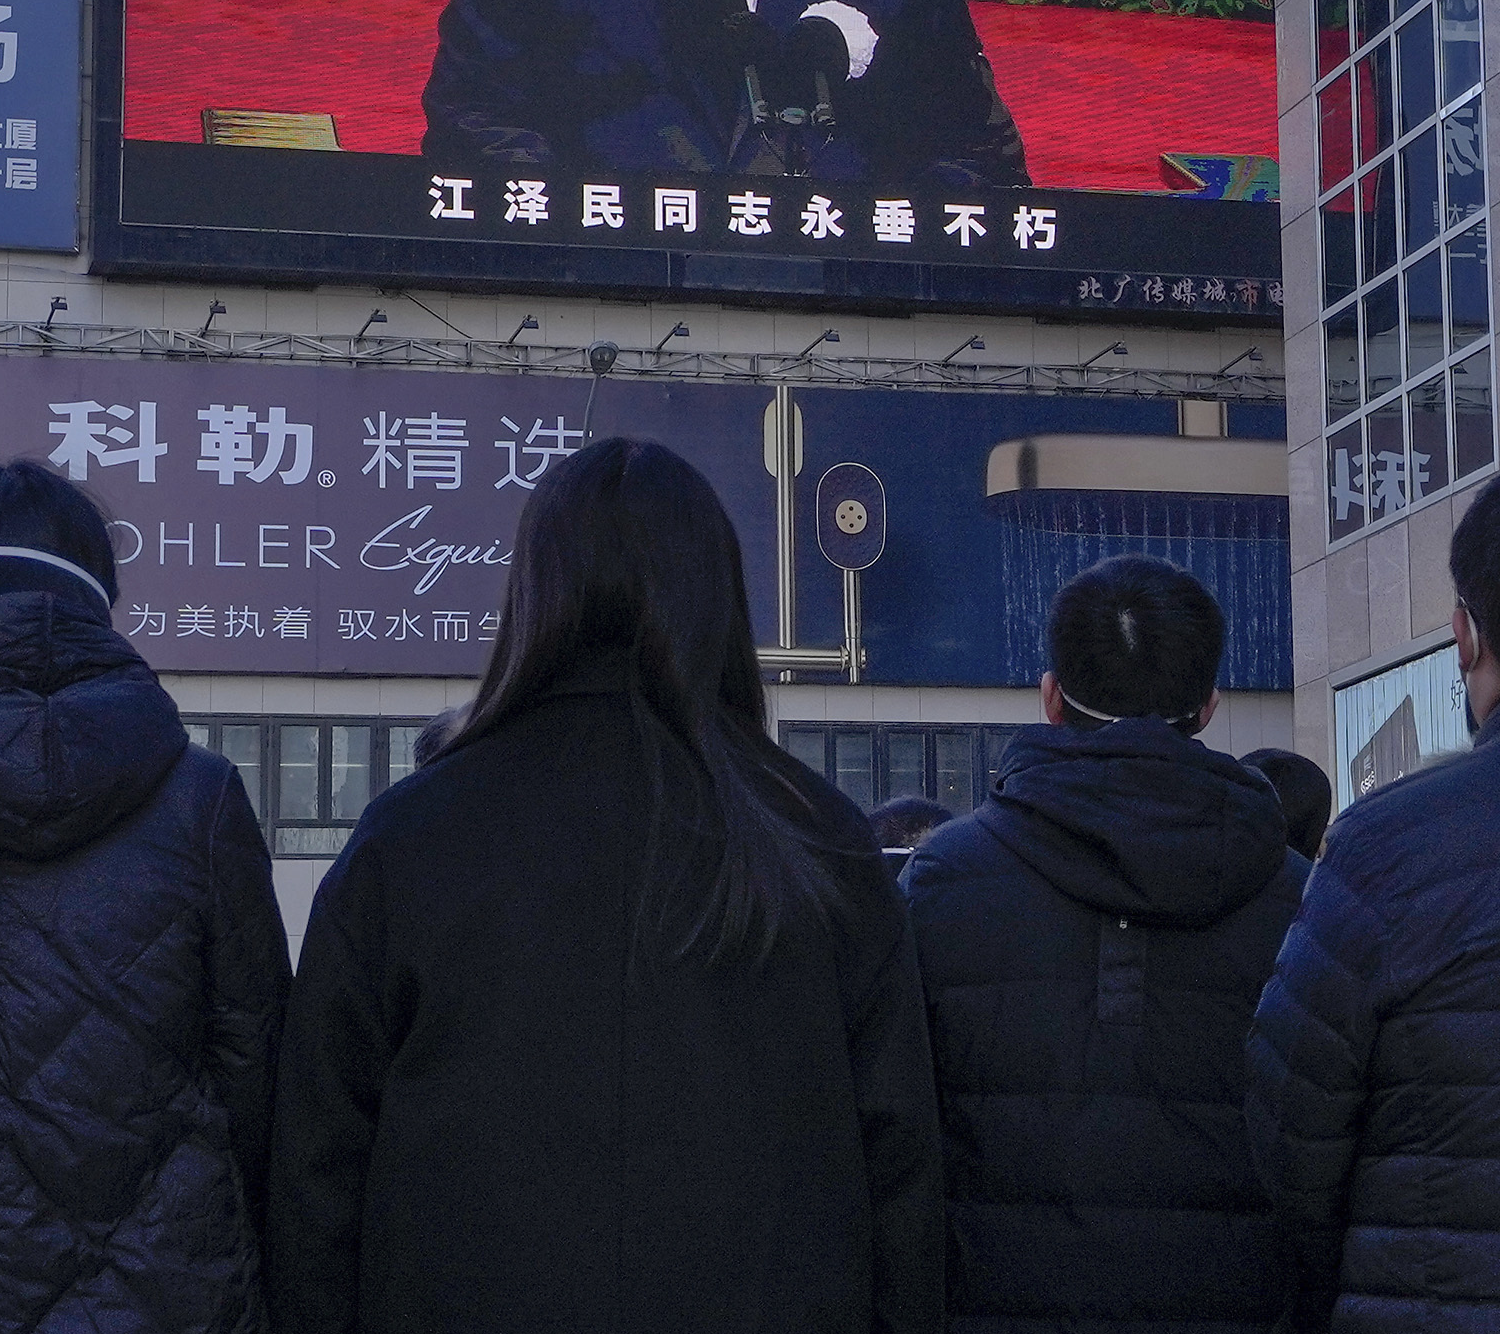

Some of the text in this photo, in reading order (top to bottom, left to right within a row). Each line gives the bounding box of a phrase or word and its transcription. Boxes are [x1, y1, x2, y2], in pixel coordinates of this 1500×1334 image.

[427, 174, 1057, 250] 江泽民同志永垂不朽
[48, 400, 314, 485] 科勒
[105, 520, 341, 569] OHLER
[128, 602, 312, 640] 为美执着
